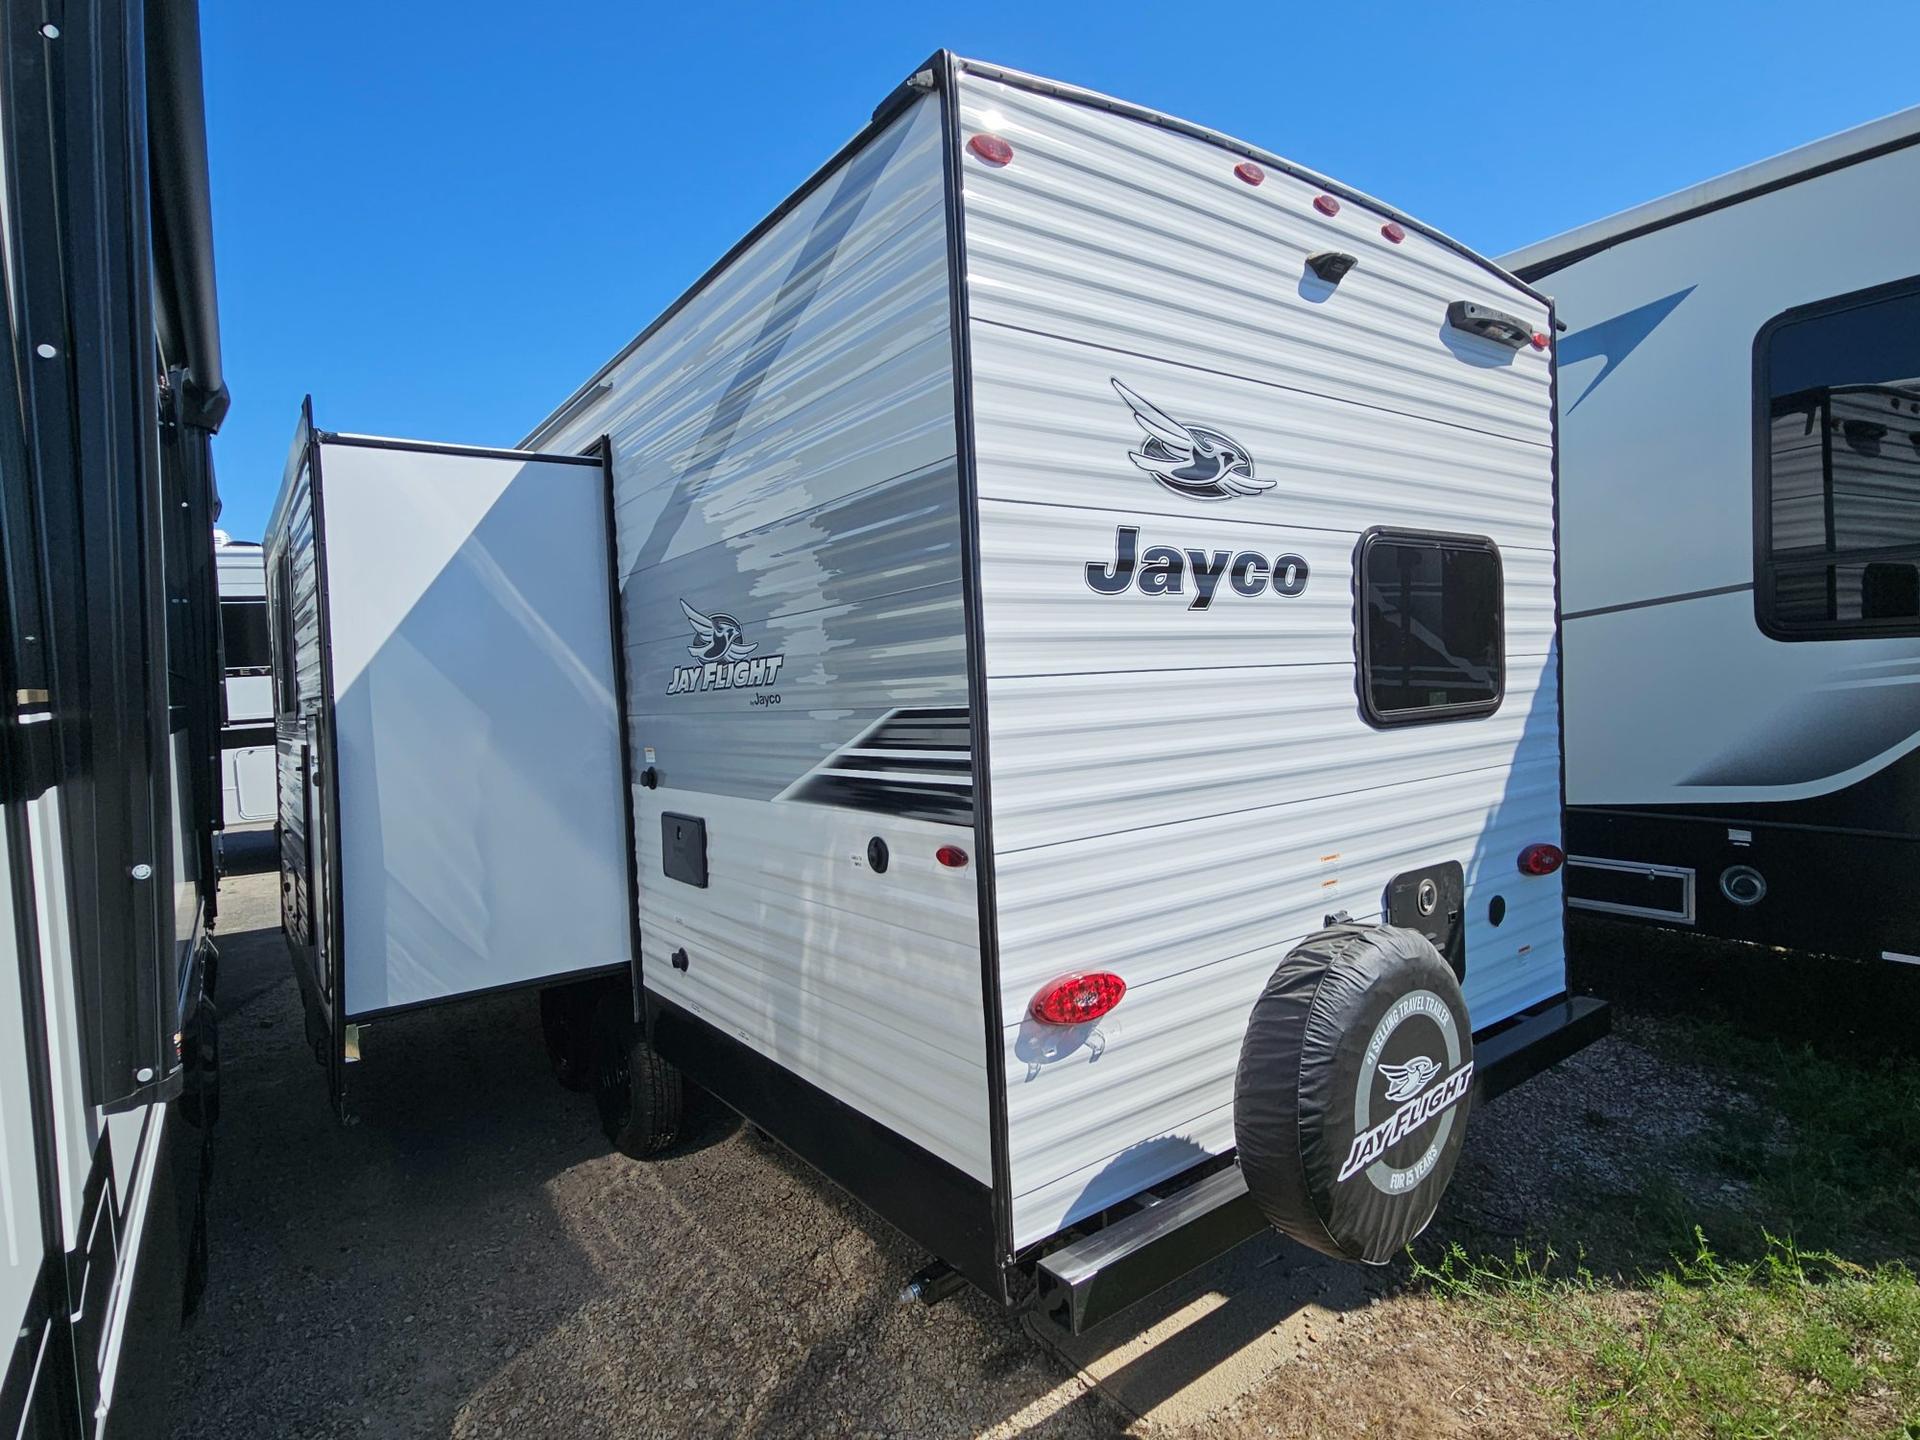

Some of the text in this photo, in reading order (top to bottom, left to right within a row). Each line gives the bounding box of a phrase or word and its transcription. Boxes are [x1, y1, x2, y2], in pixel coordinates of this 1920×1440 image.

[1084, 525, 1310, 610] Jayco
[666, 653, 784, 695] JAY FLIGHT
[754, 692, 781, 707] Jayco
[1371, 1009, 1399, 1053] SELLING
[1398, 995, 1425, 1018] TRAVEL
[1425, 996, 1450, 1027] TRAILER
[1388, 1060, 1474, 1147] FLIGHT
[1390, 1143, 1438, 1189] FOR 15 YEARS
